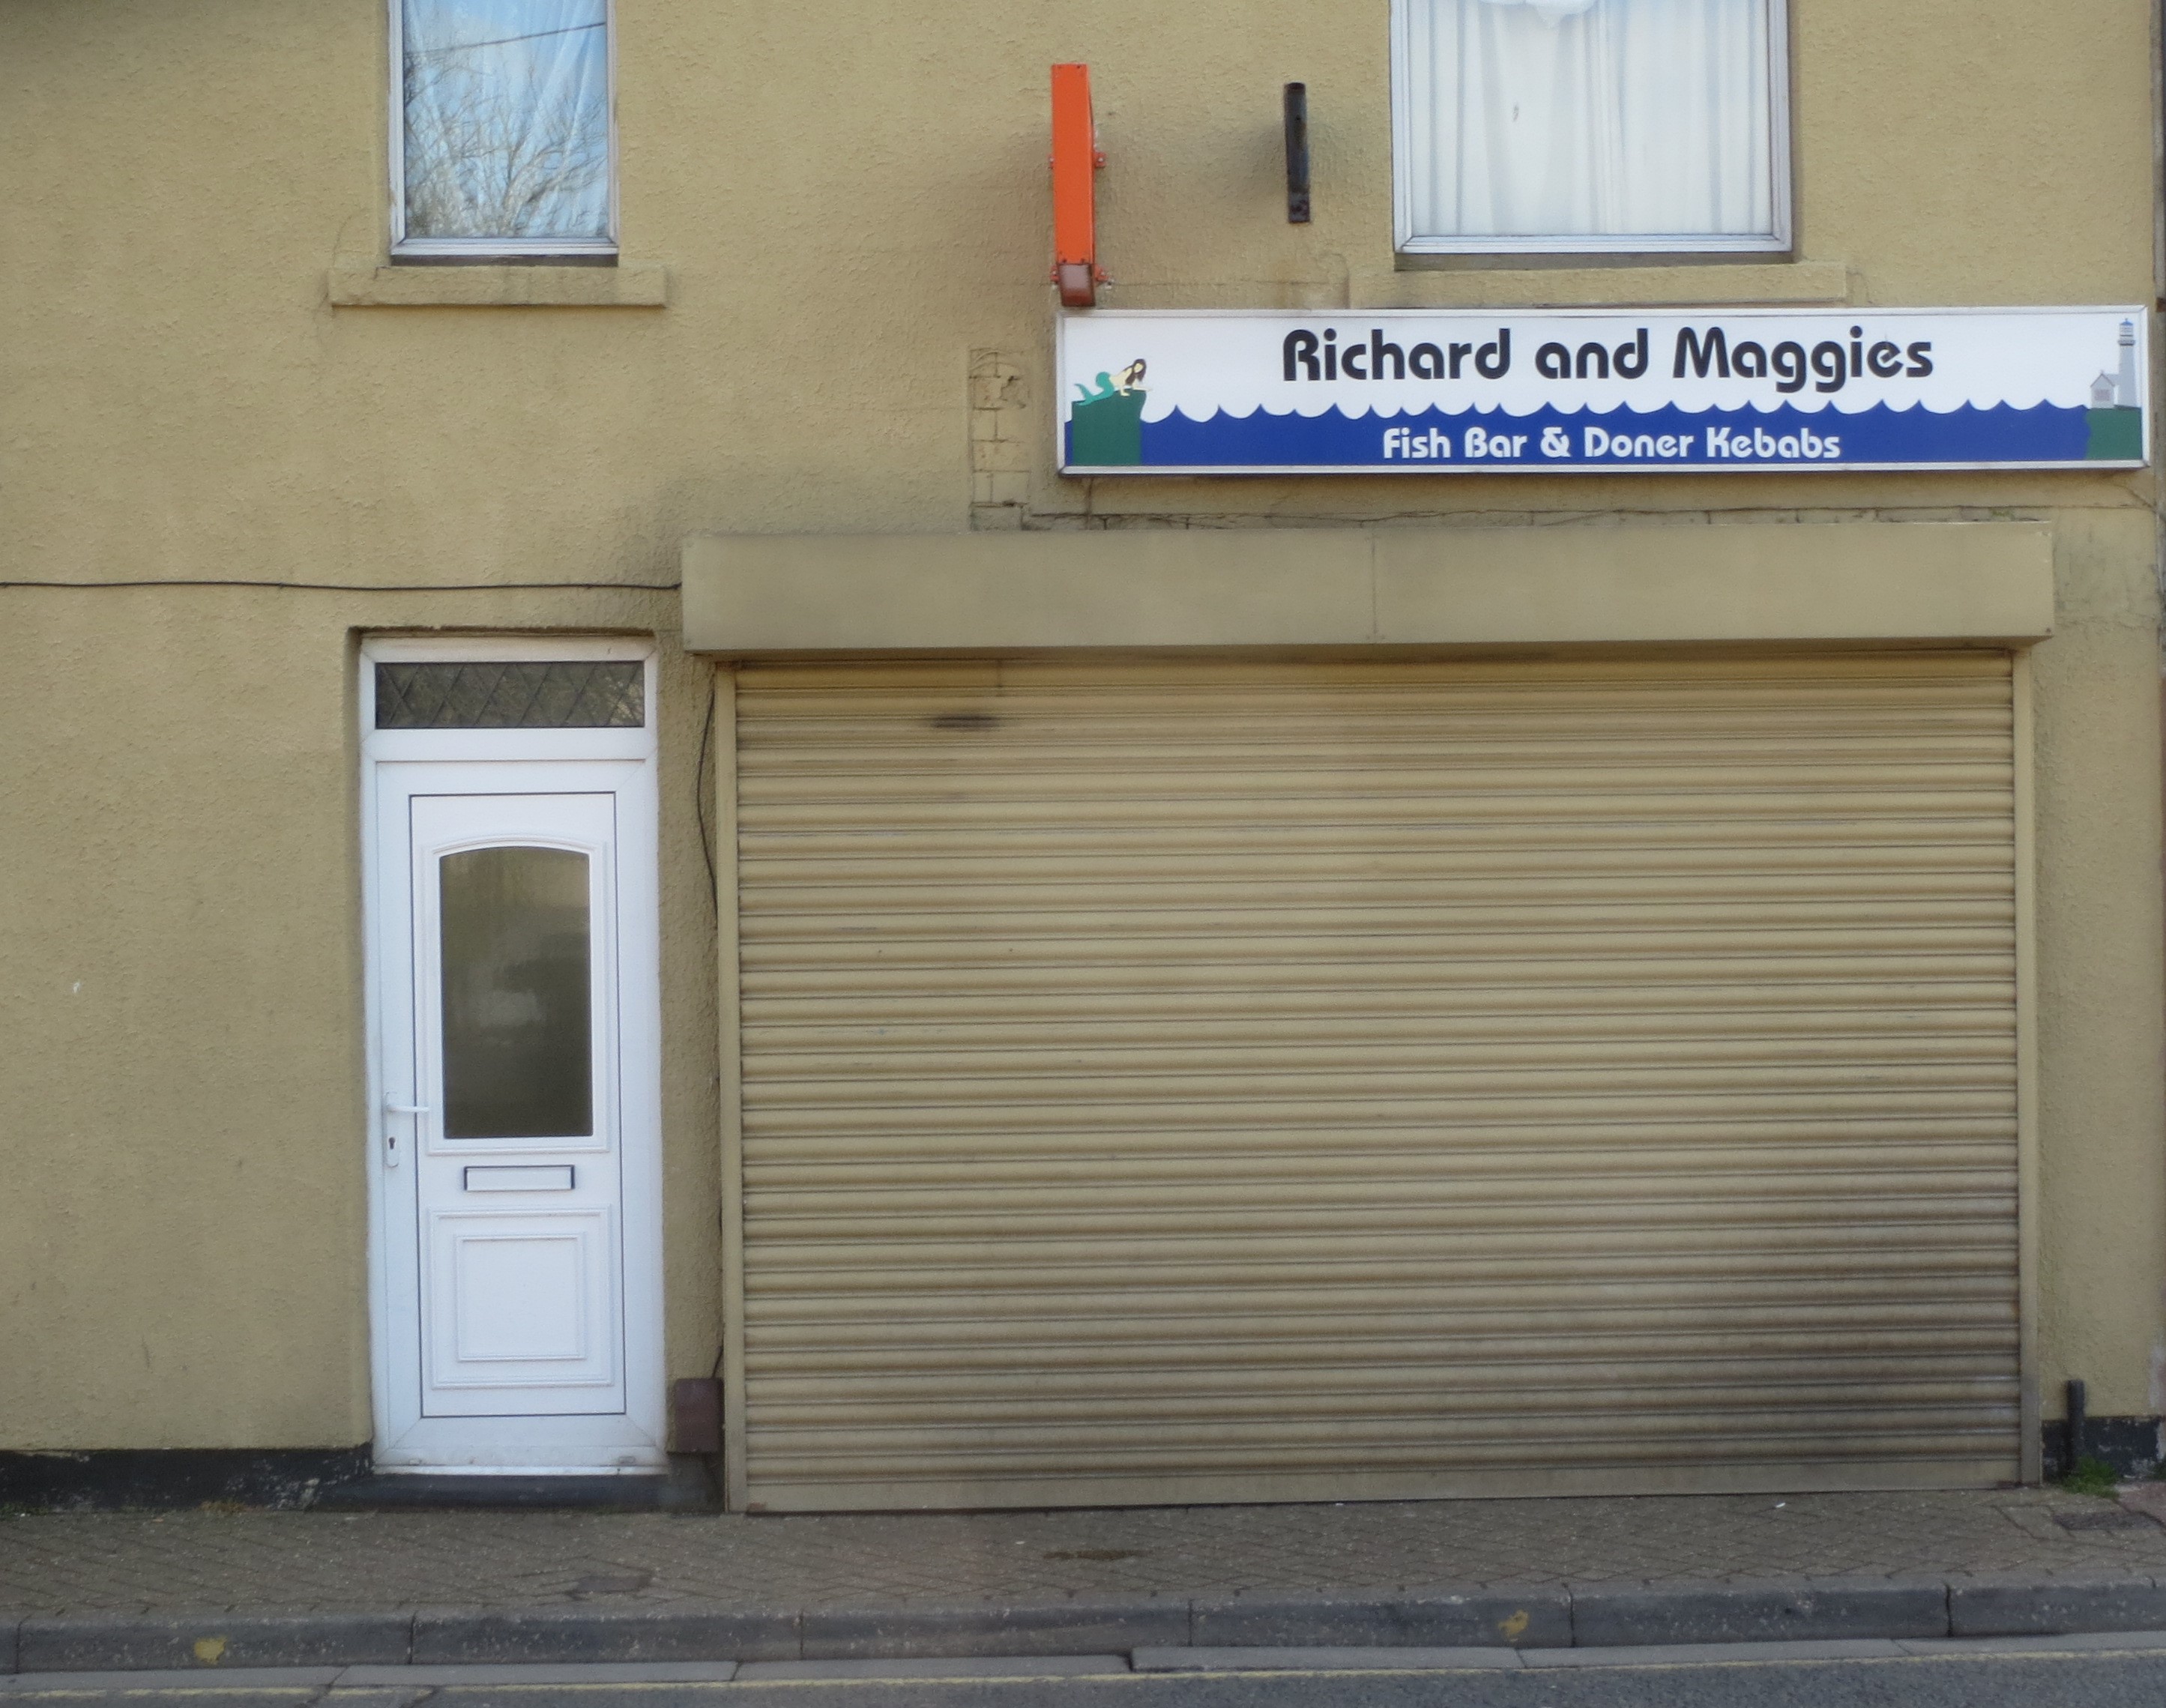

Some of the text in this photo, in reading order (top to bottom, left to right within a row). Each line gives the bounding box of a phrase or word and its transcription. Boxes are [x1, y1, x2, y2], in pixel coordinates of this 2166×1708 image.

[1282, 325, 1933, 393] Richard and Maggies
[1383, 426, 1841, 459] Fish Bar & Doner Kebabs
